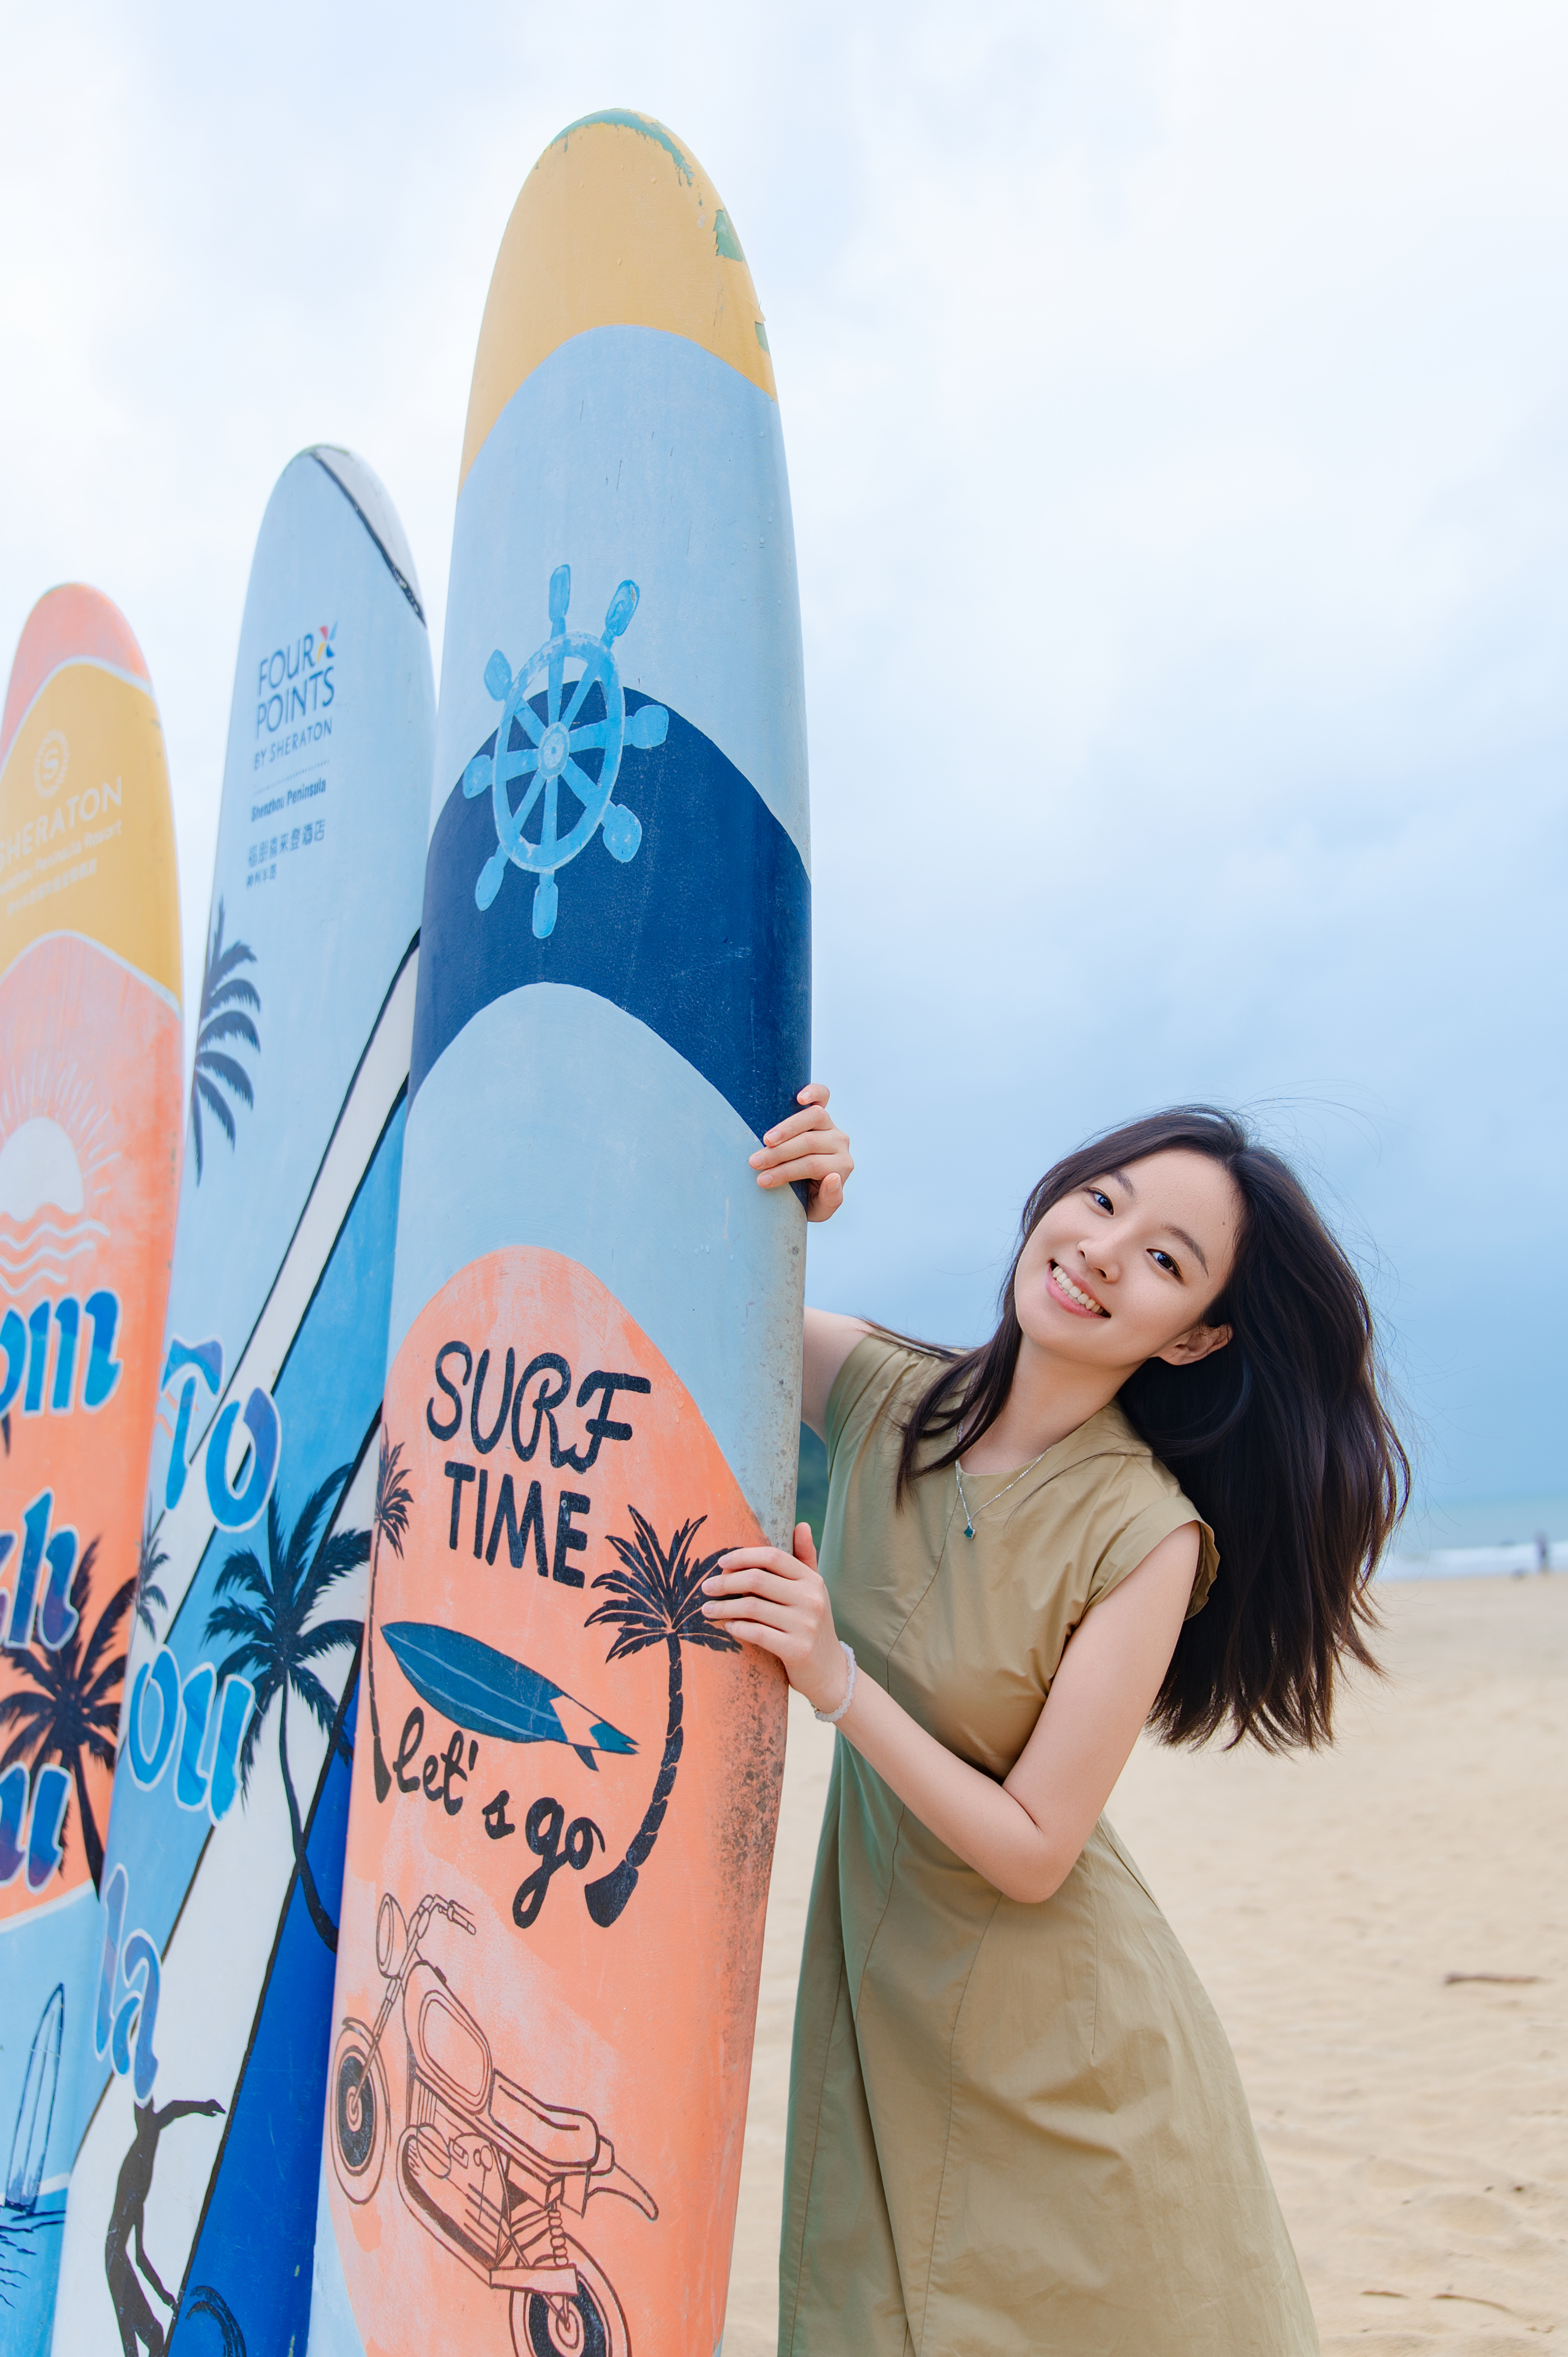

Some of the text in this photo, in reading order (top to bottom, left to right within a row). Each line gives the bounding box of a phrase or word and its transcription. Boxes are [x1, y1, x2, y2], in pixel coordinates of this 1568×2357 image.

[259, 632, 316, 698] FOUR
[256, 666, 335, 740] POINTS
[254, 717, 333, 771] BY SHERATON
[251, 776, 327, 823] Shenzhou Peninsula
[426, 1340, 652, 1474] SURF
[443, 1460, 591, 1589] TIME
[512, 1797, 606, 1929] go
